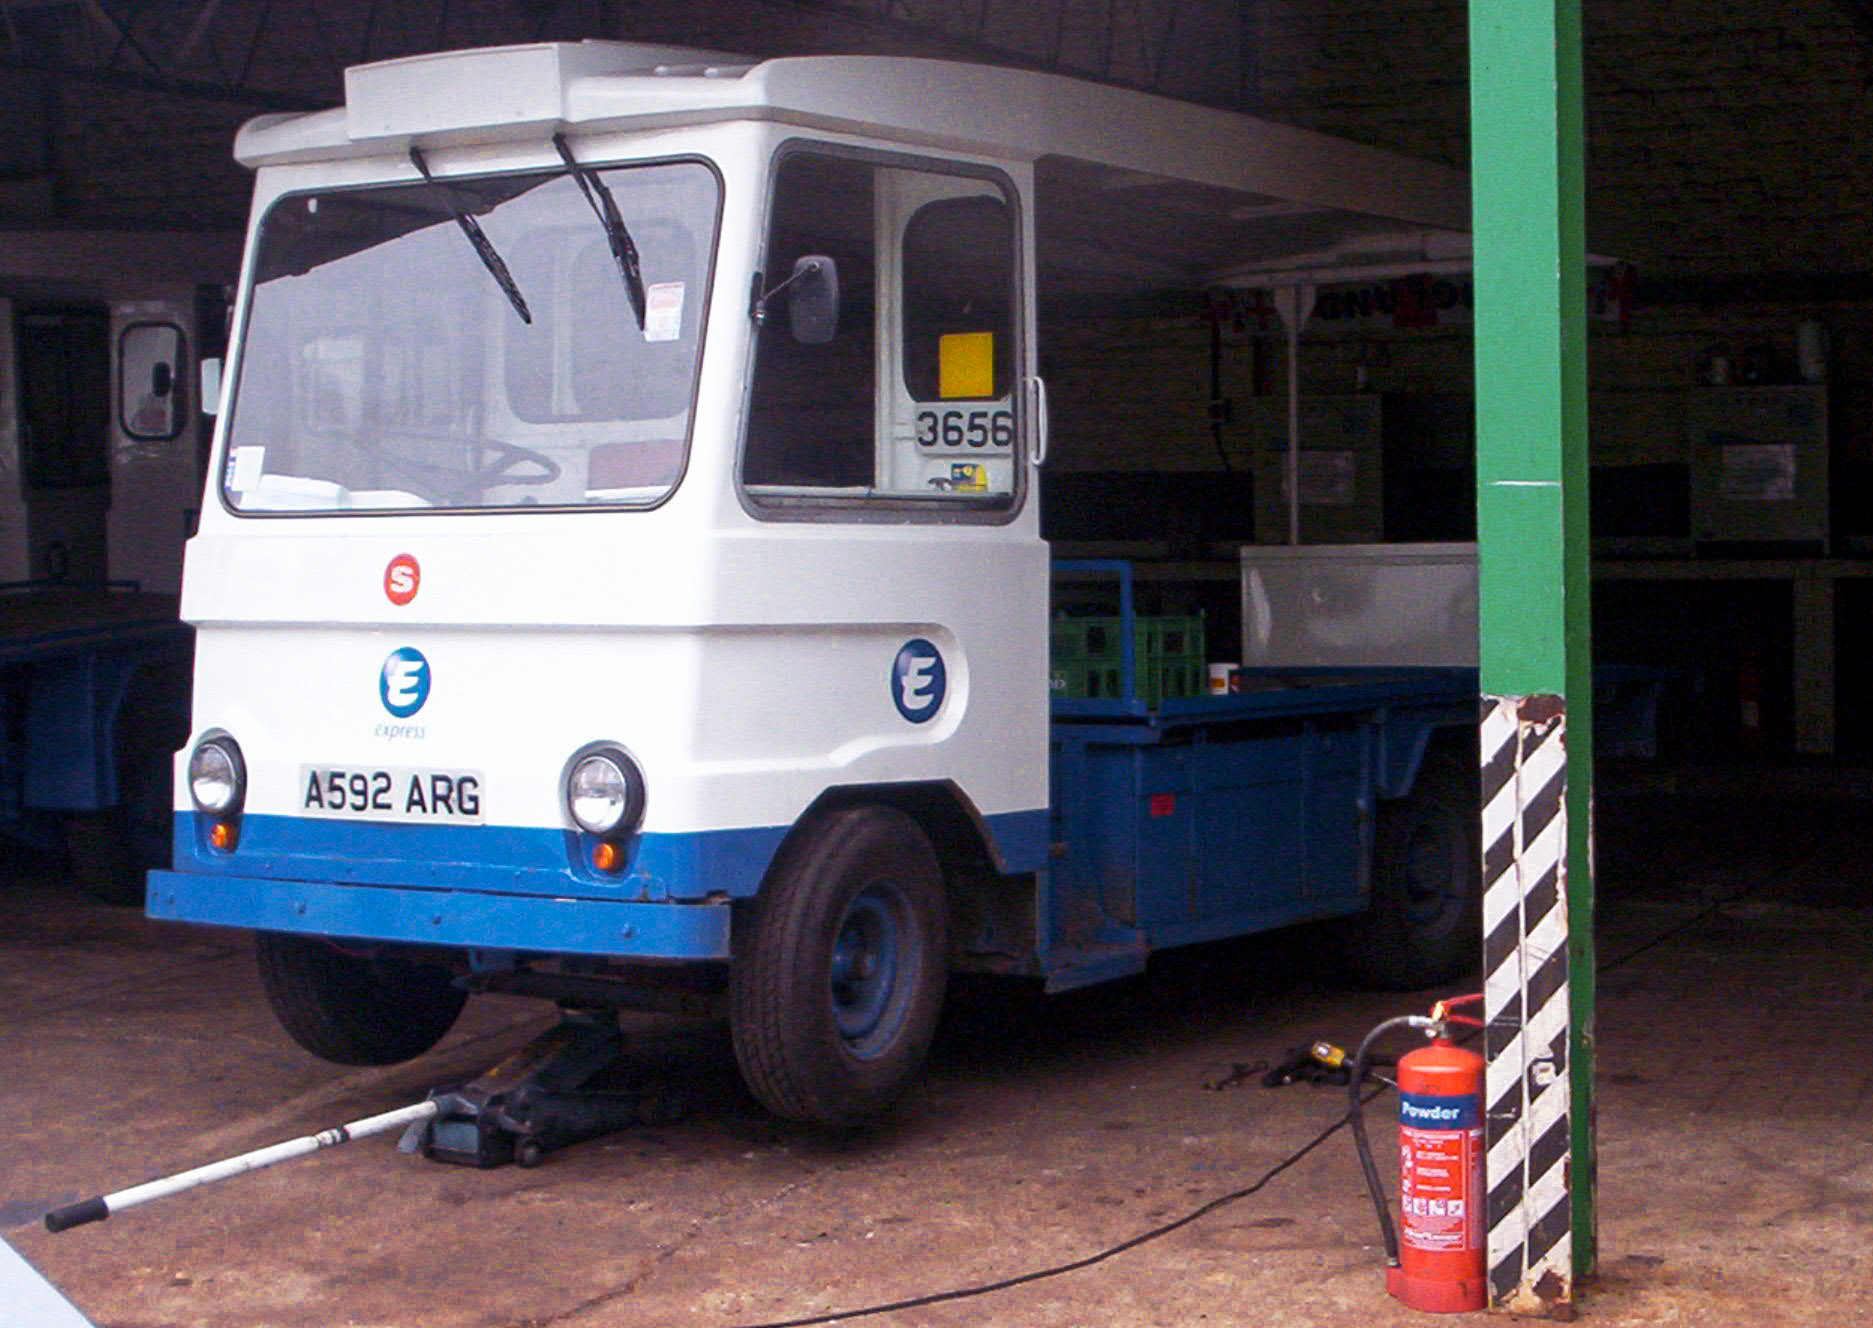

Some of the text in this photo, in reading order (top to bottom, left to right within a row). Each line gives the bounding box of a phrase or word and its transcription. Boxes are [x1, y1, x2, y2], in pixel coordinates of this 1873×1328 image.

[917, 410, 1013, 447] 3656
[390, 565, 415, 593] S
[374, 722, 426, 742] express
[304, 769, 480, 816] A592 ARG
[1402, 1101, 1460, 1120] Powder
